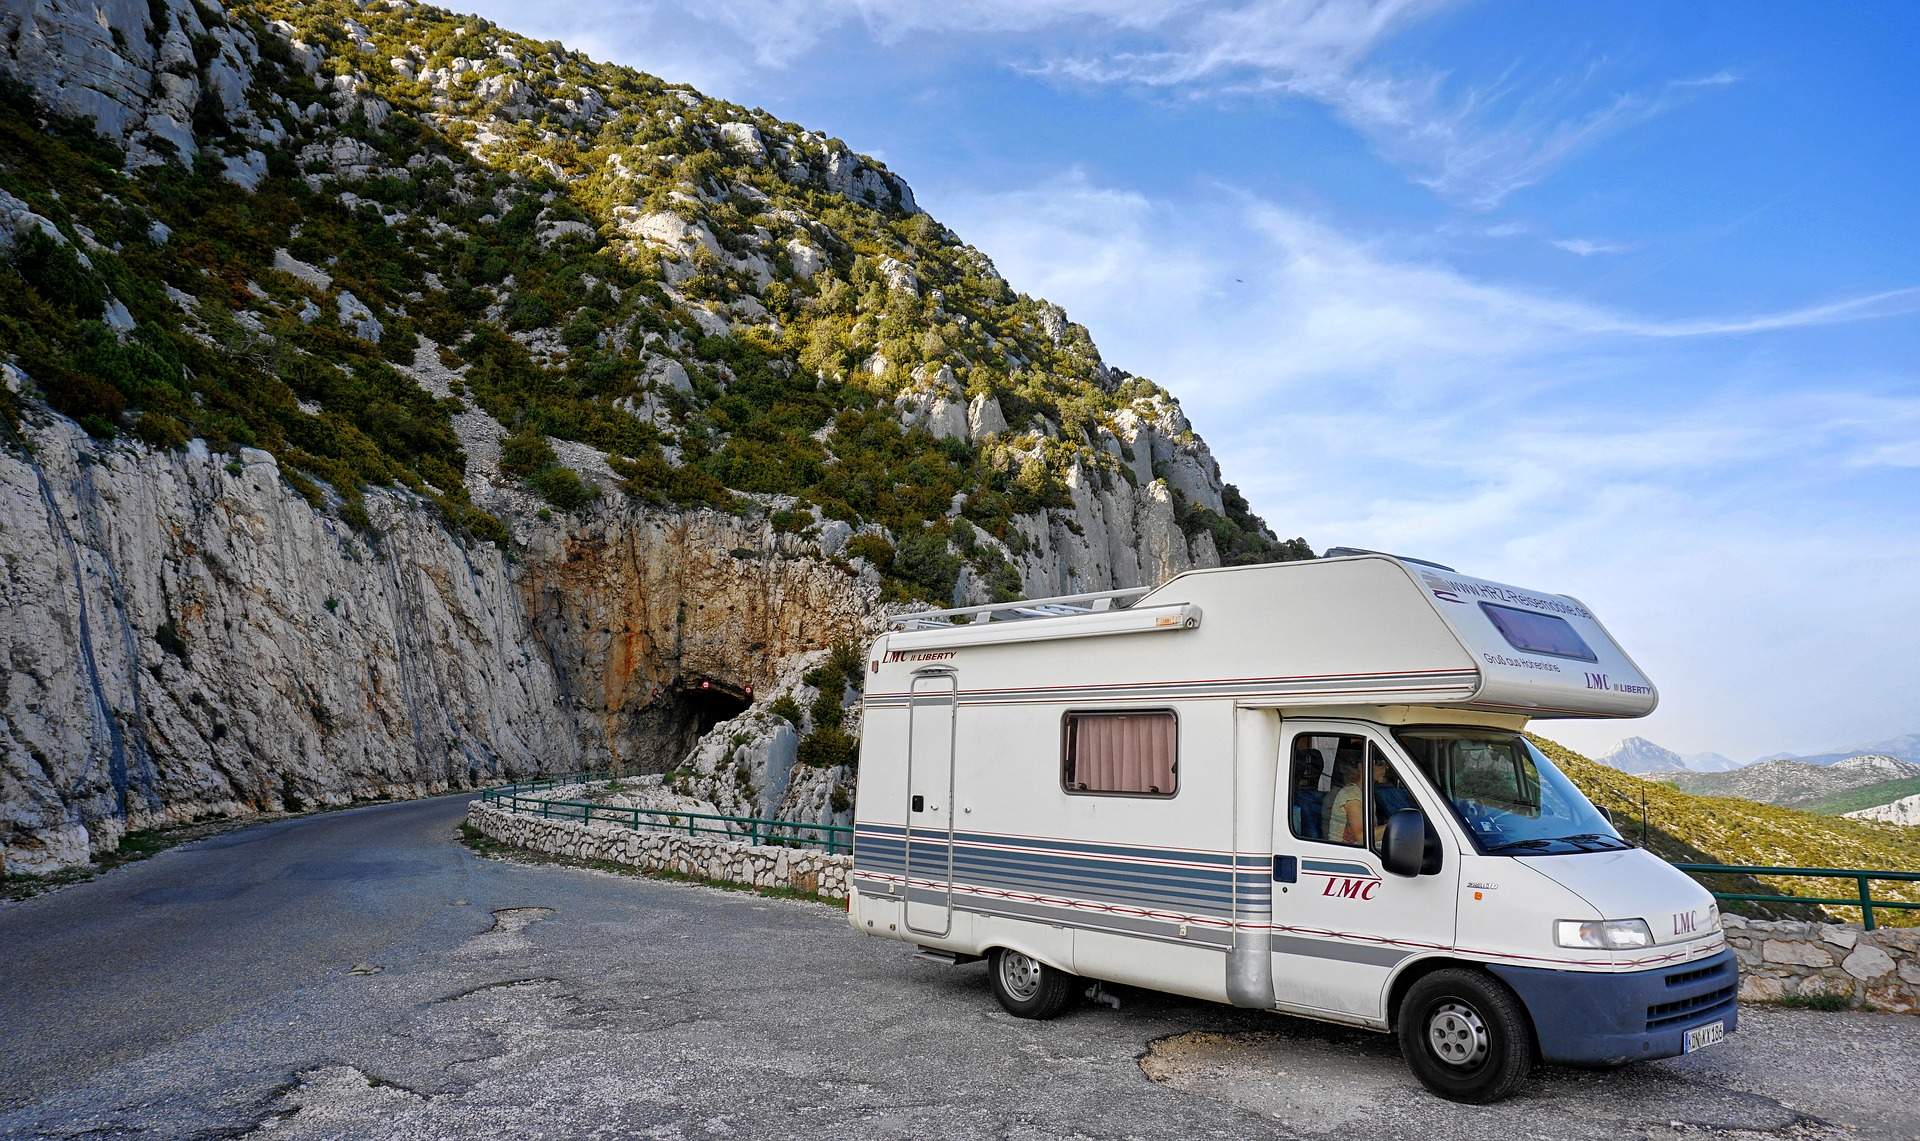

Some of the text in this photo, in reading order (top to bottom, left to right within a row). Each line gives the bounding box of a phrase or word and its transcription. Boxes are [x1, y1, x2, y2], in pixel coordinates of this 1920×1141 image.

[1445, 579, 1592, 619] www.HRZ-Reisemobile.de
[882, 651, 957, 663] LMC LIBERTY
[1483, 653, 1506, 665] Gruß
[1584, 672, 1650, 695] LMC LIBERTY
[1322, 878, 1381, 900] LMC
[1673, 910, 1697, 935] LMC
